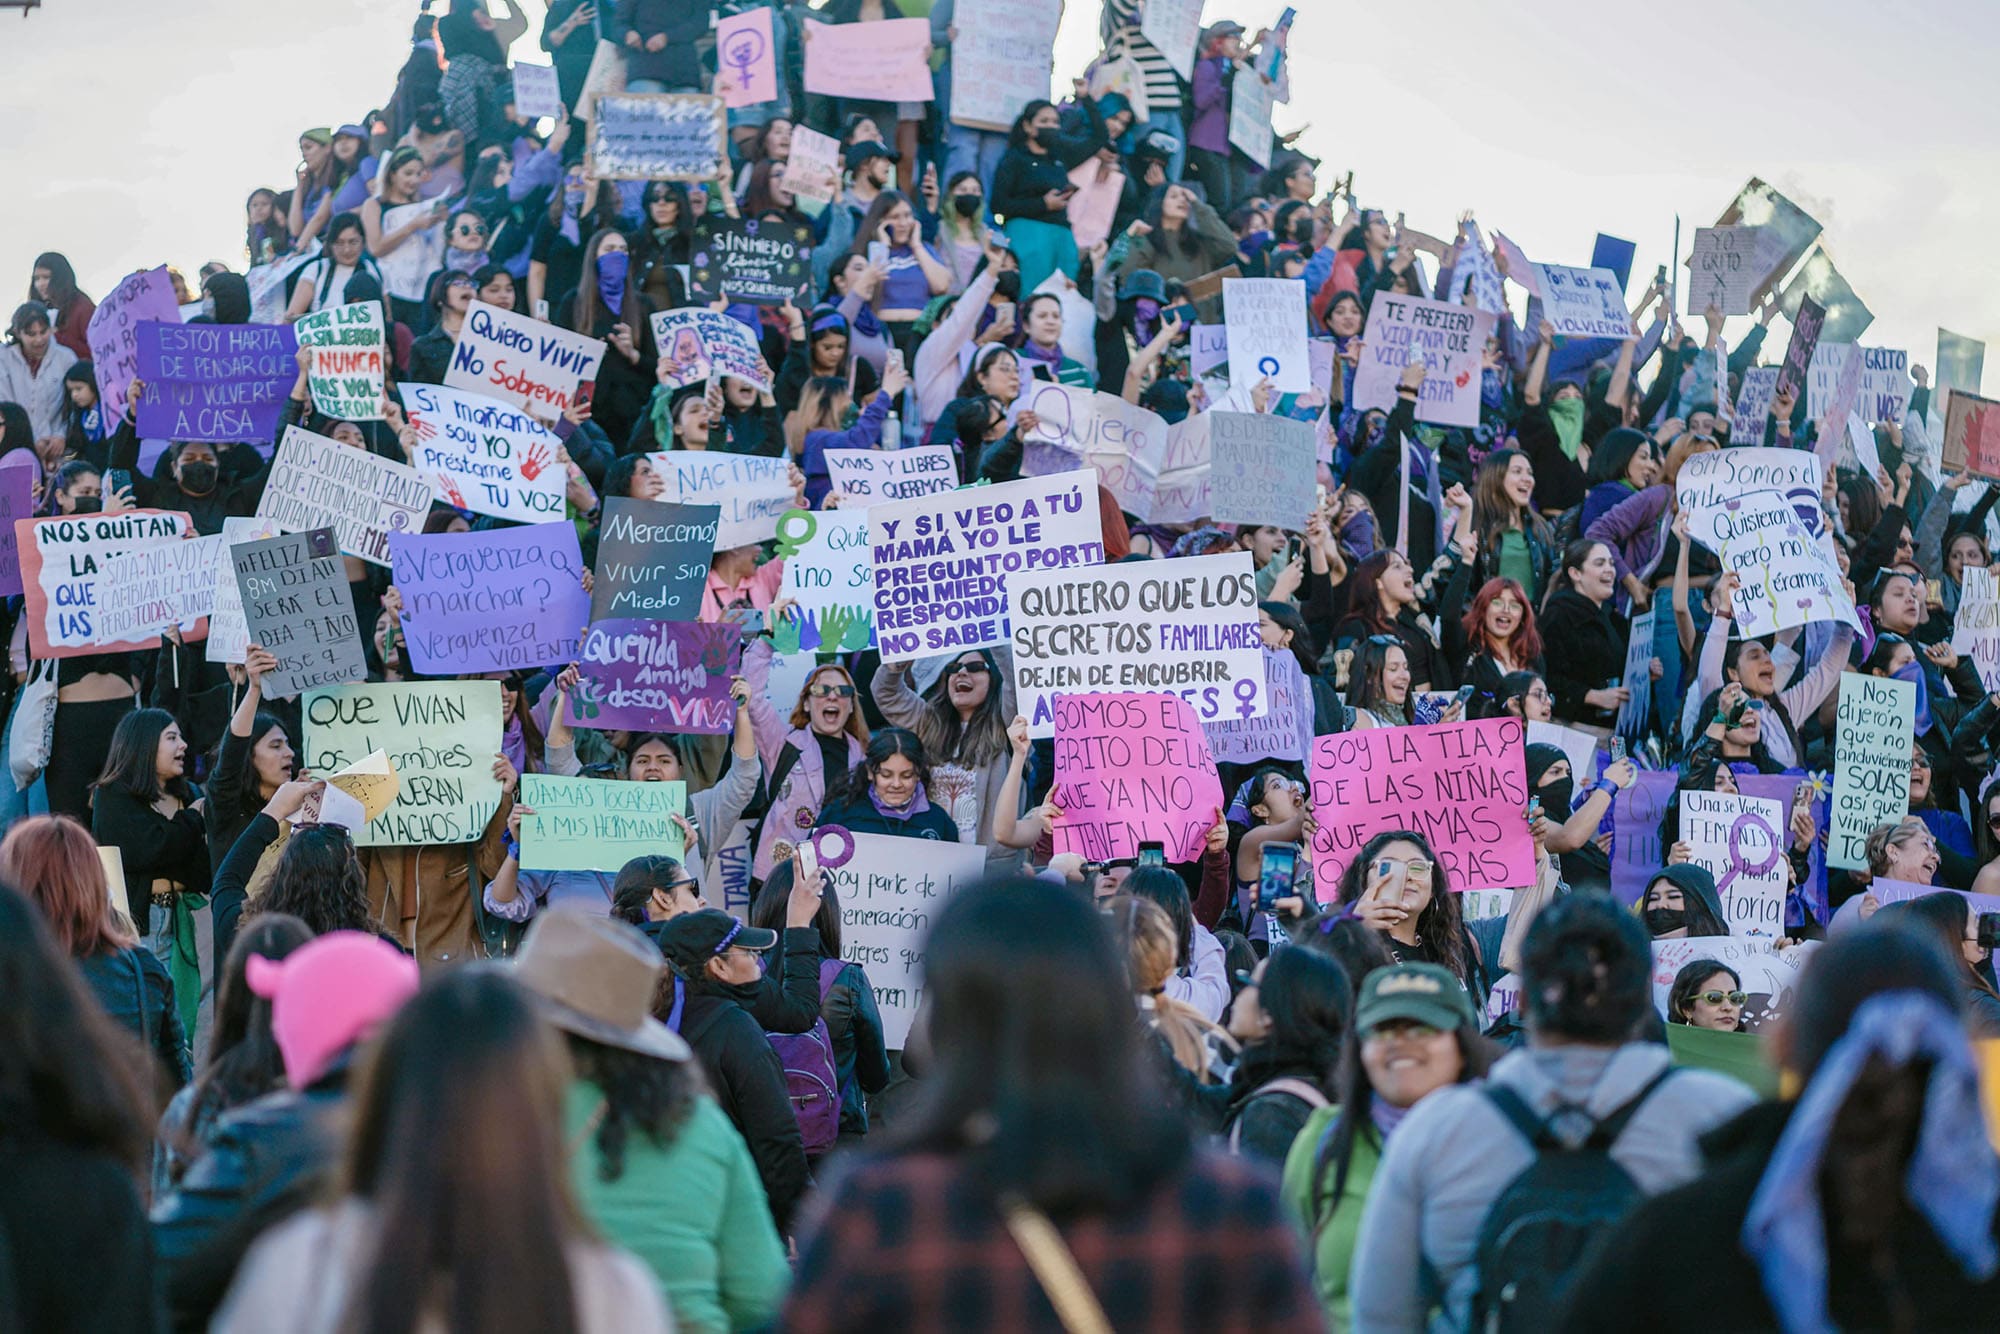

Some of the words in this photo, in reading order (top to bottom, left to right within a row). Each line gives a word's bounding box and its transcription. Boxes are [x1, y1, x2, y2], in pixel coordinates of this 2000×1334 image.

[750, 237, 794, 259] MIEDO
[1711, 231, 1734, 250] YO
[298, 312, 331, 333] POR
[336, 305, 371, 325] LAS
[1385, 301, 1406, 322] TE
[1412, 306, 1475, 332] PREFIERO
[1554, 319, 1629, 335] VOLVIERON
[159, 327, 220, 353] ESTOY
[229, 328, 284, 353] HARTA
[471, 310, 533, 353] Quiero
[540, 336, 594, 376] Vivir
[1447, 332, 1470, 353] QUE
[161, 354, 187, 379] DE
[194, 356, 258, 378] PENSAR
[260, 354, 293, 376] QUE
[319, 352, 381, 375] NUNCA
[454, 341, 484, 375] No
[1442, 355, 1451, 373] Y
[1864, 348, 1906, 371] GRITO
[144, 382, 161, 405] YA
[172, 383, 194, 405] NO
[204, 377, 279, 405] VOLVERÉ
[174, 410, 191, 435] A
[199, 408, 255, 436] CASA
[416, 388, 440, 412] Si
[454, 400, 548, 437] mañana
[1032, 386, 1147, 455] Quiero
[1877, 392, 1904, 423] VOZ
[446, 424, 476, 454] soy
[483, 434, 510, 459] YO
[282, 437, 314, 469] NOS
[319, 449, 382, 493] QUITARON
[382, 470, 432, 512] TANTO
[744, 458, 788, 482] PARA
[831, 457, 874, 471] VIVAS
[882, 459, 895, 476] Y
[902, 455, 951, 474] LIBRES
[1724, 450, 1799, 485] Somos
[1803, 457, 1815, 485] el
[276, 465, 305, 497] QUE
[307, 474, 385, 525] TERMINARON
[480, 483, 508, 508] TU
[518, 489, 562, 513] VOZ
[842, 479, 871, 495] NOS
[734, 497, 796, 523] LIBRE
[881, 520, 901, 540] Y
[915, 513, 944, 536] SI
[955, 502, 1014, 528] VEO
[1021, 499, 1041, 520] A
[1045, 484, 1083, 515] TÚ
[1713, 508, 1793, 540] Quisieron
[42, 521, 90, 544] NOS
[603, 514, 717, 545] Merecemos
[874, 529, 956, 565] MAMÁ
[962, 528, 999, 550] YO
[1008, 522, 1041, 545] LE
[70, 554, 98, 577] LA
[172, 540, 207, 571] VOY
[875, 551, 1022, 589] PREGUNTO
[1026, 545, 1079, 570] POR
[1732, 545, 1772, 582] pero
[1779, 540, 1802, 558] no
[56, 582, 97, 607] QUE
[101, 579, 159, 613] CAMBIAR
[246, 577, 277, 600] 8M
[610, 585, 681, 611] Miedo
[874, 584, 930, 610] CON
[1020, 580, 1130, 616] QUIERO
[1138, 578, 1197, 613] QUE
[1200, 573, 1257, 608] LOS
[1733, 582, 1765, 612] que
[1965, 567, 1974, 599] A
[101, 609, 131, 637] PERO
[135, 598, 174, 627] TODAS
[254, 593, 303, 620] SERÁ
[315, 586, 345, 607] EL
[59, 611, 93, 638] LAS
[259, 624, 295, 648] DIA
[326, 614, 357, 638] NO
[880, 632, 920, 657] NO
[926, 619, 997, 650] SABE
[583, 622, 679, 670] Querida
[1015, 622, 1152, 659] SECRETOS
[1160, 622, 1261, 652] FAMILIARES
[291, 663, 359, 691] LLEGUE
[1018, 666, 1082, 689] DEJEN
[1088, 664, 1114, 687] DE
[1120, 660, 1232, 687] ENCUBRIR
[393, 693, 466, 727] VIVAN
[668, 696, 733, 731] VIVA
[1055, 699, 1147, 732] SOMOS
[1161, 701, 1190, 733] EL
[1317, 736, 1373, 772] SOY
[1386, 733, 1422, 764] LA
[1428, 727, 1492, 759] TIA
[1842, 728, 1875, 751] que
[1883, 734, 1905, 750] no
[1056, 735, 1131, 773] GRITO
[1143, 736, 1182, 767] DE
[1185, 738, 1218, 777] LAS
[598, 784, 675, 811] TOCARAN
[1053, 782, 1096, 810] QUE
[1100, 778, 1134, 811] YA
[1141, 776, 1193, 814] NO
[1313, 779, 1350, 806] DE
[1365, 774, 1424, 804] LAS
[1434, 762, 1525, 806] NIÑAS
[1848, 771, 1907, 805] SOLAS
[1687, 793, 1720, 813] Una
[1738, 797, 1771, 817] Vuelve
[1840, 797, 1871, 817] así
[1873, 804, 1901, 829] que
[371, 811, 461, 843] MACHOS
[536, 816, 546, 837] A
[554, 815, 588, 837] MIS
[1313, 823, 1367, 853] QUE
[1686, 818, 1783, 848] FEMINISTA
[925, 873, 947, 897] de
[1723, 945, 1739, 961] ES
[1744, 943, 1757, 957] UN
